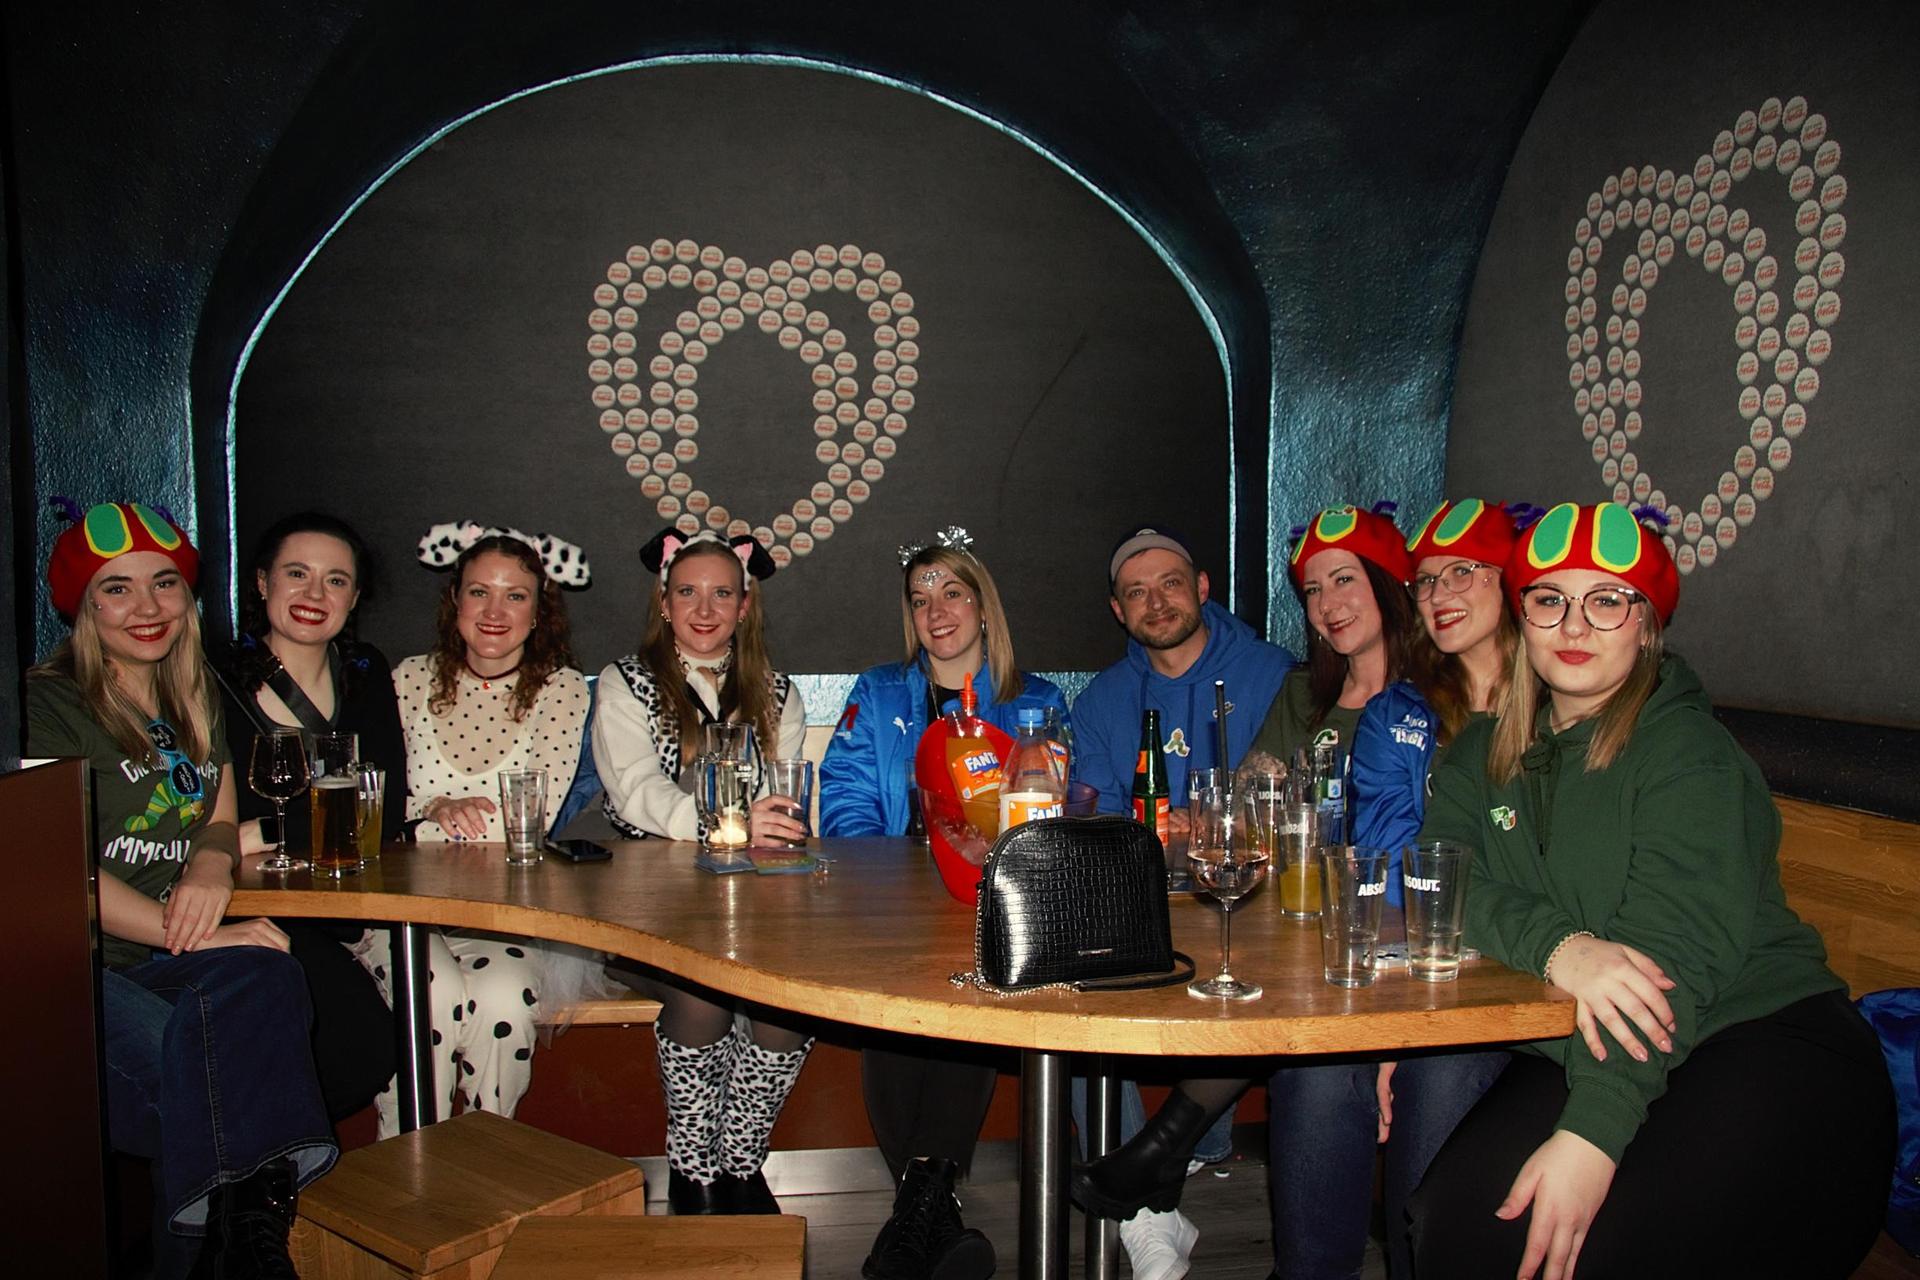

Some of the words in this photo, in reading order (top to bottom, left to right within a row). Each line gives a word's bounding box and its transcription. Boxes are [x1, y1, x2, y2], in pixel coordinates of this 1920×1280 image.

[964, 752, 998, 772] FANT
[1027, 803, 1063, 821] FANT
[1404, 875, 1441, 892] SOLUT.
